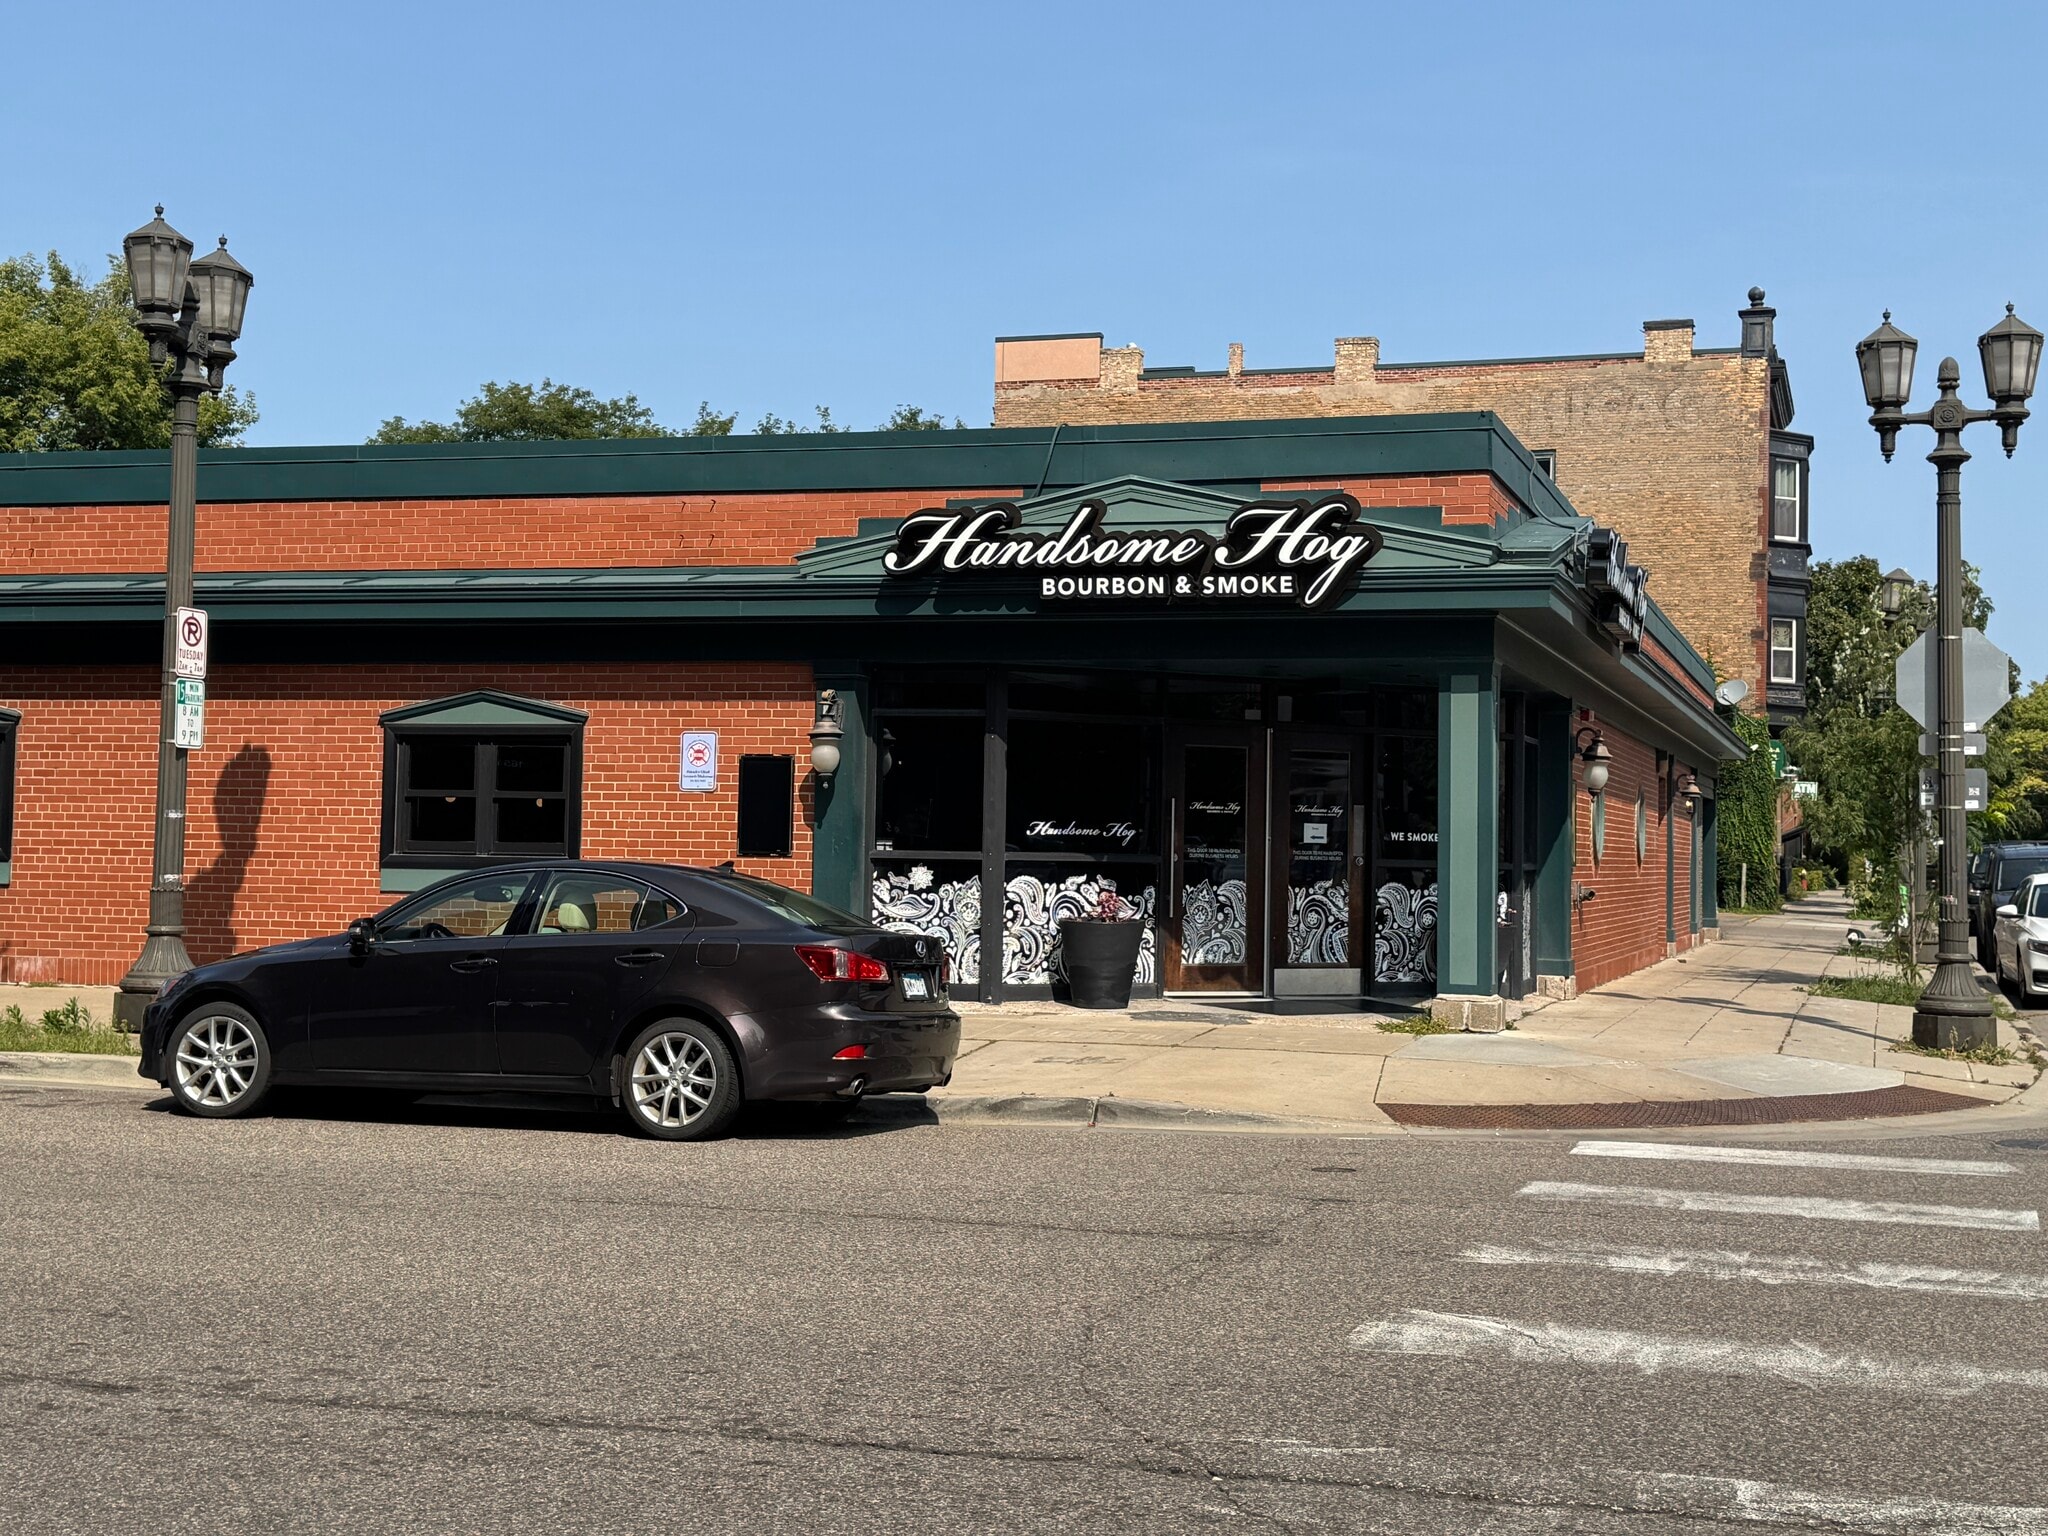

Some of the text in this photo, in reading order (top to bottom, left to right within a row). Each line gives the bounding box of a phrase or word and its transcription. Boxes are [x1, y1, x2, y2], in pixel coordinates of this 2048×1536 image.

[885, 504, 1370, 604] Handsome Hog
[1042, 576, 1293, 596] BOURBON & SMOKE
[180, 648, 203, 661] TUESDAY
[178, 682, 185, 700] 15
[182, 706, 199, 716] 8 AM
[187, 718, 194, 727] TO
[182, 730, 198, 741] 9 PM
[1794, 784, 1816, 794] ATM
[1026, 820, 1136, 846] Handsome Hog
[1390, 832, 1438, 842] WE SMOKE
